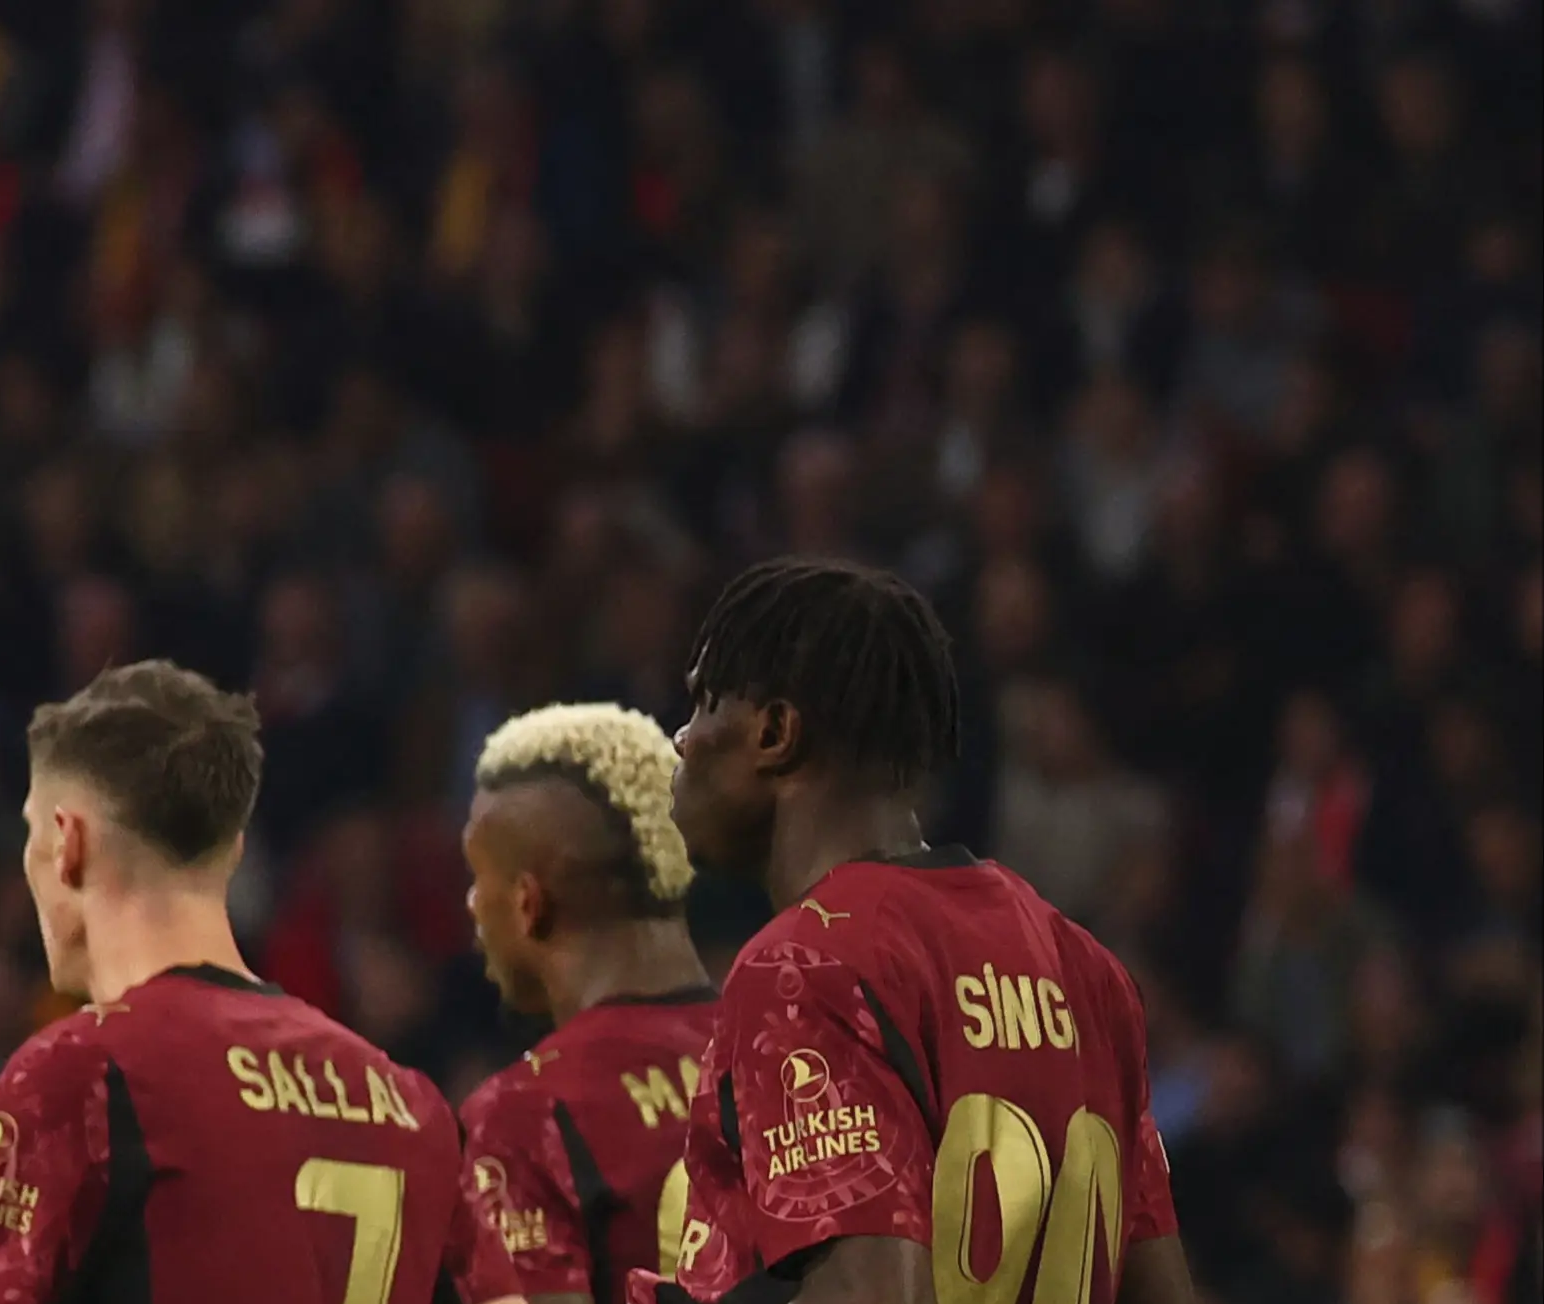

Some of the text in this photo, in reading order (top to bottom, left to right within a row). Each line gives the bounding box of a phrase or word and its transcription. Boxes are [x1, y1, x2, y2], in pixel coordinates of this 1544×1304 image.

[955, 962, 1079, 1059] SİNG
[763, 1104, 876, 1152] TURKISH
[768, 1129, 881, 1180] AIRLINES
